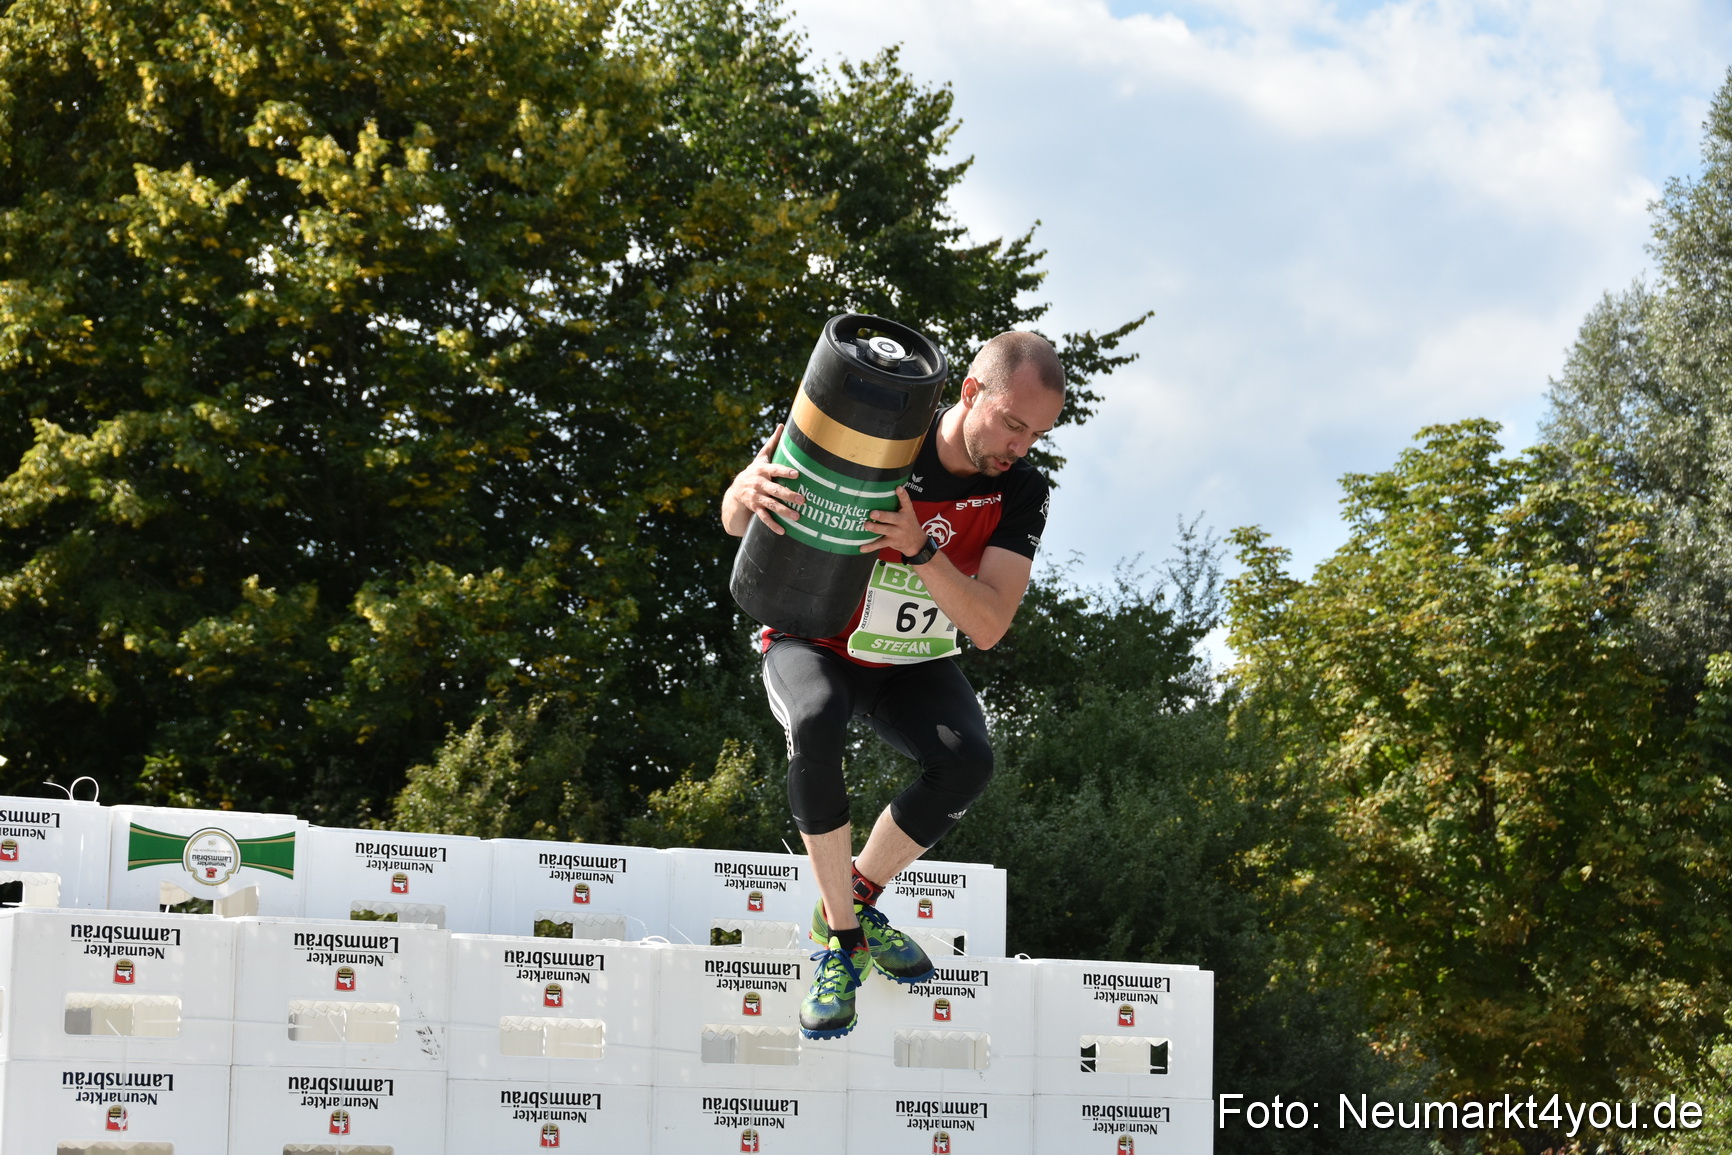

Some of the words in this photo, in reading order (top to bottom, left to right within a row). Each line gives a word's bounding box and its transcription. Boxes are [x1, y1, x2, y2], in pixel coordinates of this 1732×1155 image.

[797, 484, 869, 517] Neumarkter
[896, 602, 939, 634] 61
[871, 639, 931, 655] STEFAN
[355, 842, 447, 862] Lammsbräu
[366, 859, 434, 873] Neumarkter
[538, 853, 627, 873] Lammsbräu
[549, 870, 614, 884] Neumarkter
[714, 862, 799, 881] Lammsbräu
[892, 871, 966, 888] Lammsbrä
[724, 878, 787, 892] Neumarkter
[895, 886, 955, 899] Neumarkter
[70, 924, 181, 945] Lammsbräu
[294, 932, 399, 953] Lammsbräu
[84, 943, 165, 959] Neumarkter
[306, 951, 384, 967] Neumarkter
[504, 950, 605, 970] Lammsbräu
[516, 969, 590, 983] Neumarkter
[704, 959, 801, 979] Lammsbräu
[716, 978, 788, 992] Neumarkter
[1083, 973, 1171, 992] Lammsbräu
[908, 985, 976, 998] Neumarkter
[1093, 991, 1158, 1004] Neumarkter
[62, 1071, 173, 1091] Lammsbräu
[288, 1076, 393, 1095] Lammsbräu
[75, 1091, 158, 1105] Neumarkter
[300, 1095, 379, 1109] Neumarkter
[500, 1090, 601, 1110] Lammsbräu
[702, 1097, 799, 1116] Lammsbräu
[896, 1100, 987, 1118] Lammsbräu
[1082, 1104, 1170, 1122] Lammsbräu
[513, 1108, 587, 1123] Neumarkter
[714, 1115, 785, 1129] Neumarkter
[907, 1118, 974, 1131] Neumarkter
[1092, 1121, 1158, 1135] Neumarkter
